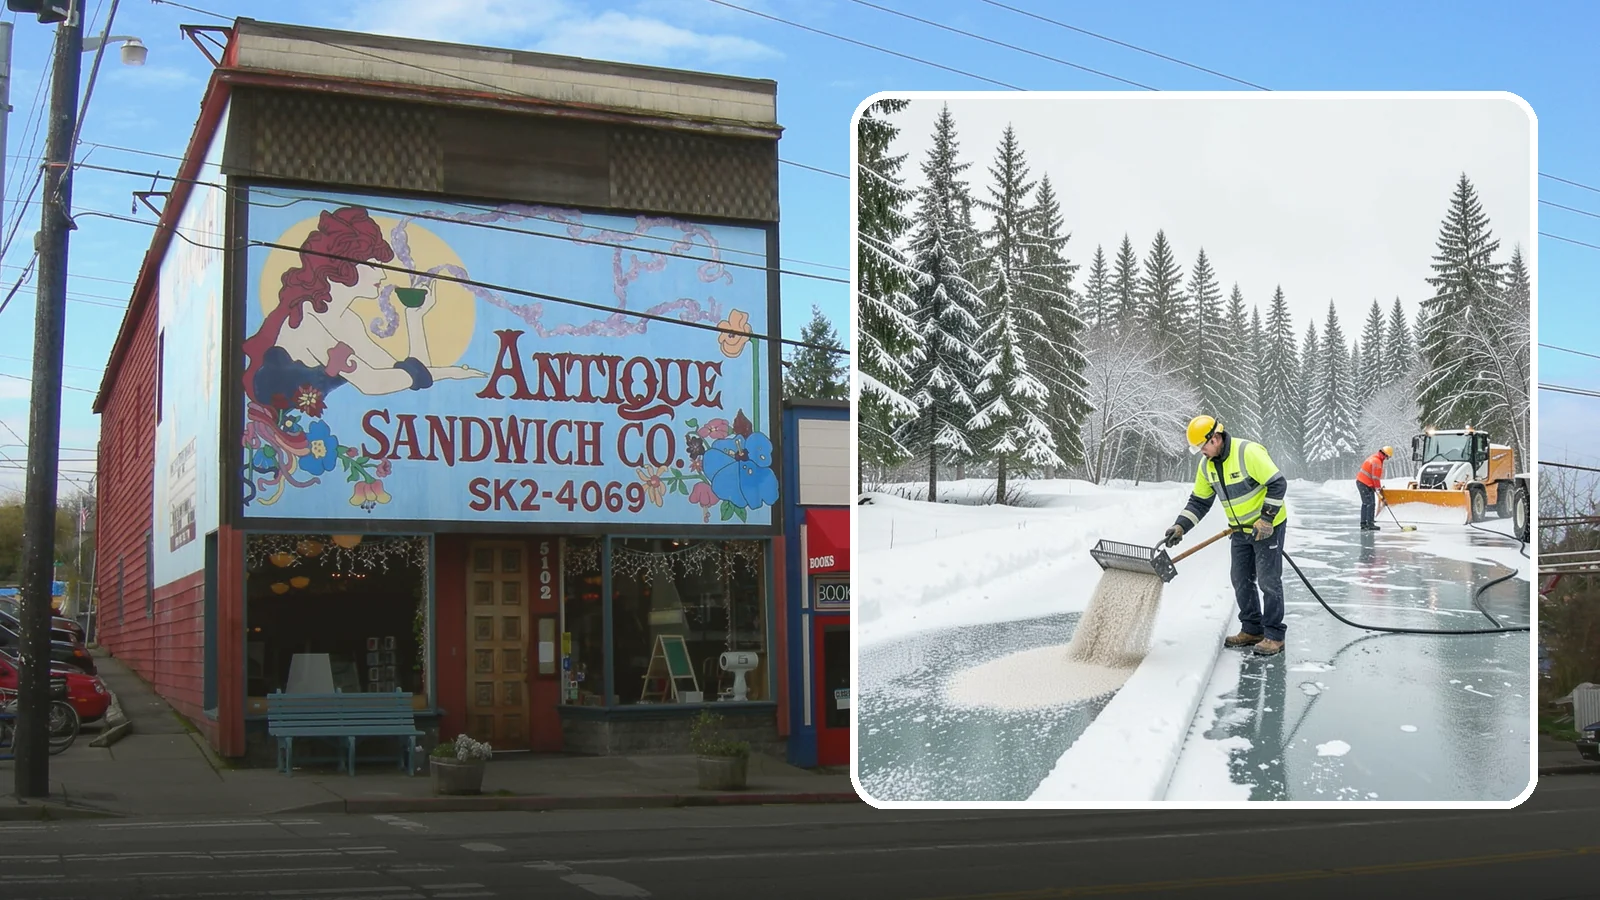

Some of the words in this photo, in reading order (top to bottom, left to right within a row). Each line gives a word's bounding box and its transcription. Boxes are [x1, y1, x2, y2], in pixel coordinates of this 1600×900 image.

[476, 329, 723, 421] ANTIQUE
[361, 408, 604, 467] SANDWICH
[618, 421, 685, 470] CO.
[468, 477, 646, 513] SK2-4069
[540, 541, 551, 599] 5102
[809, 555, 835, 569] BOOKS
